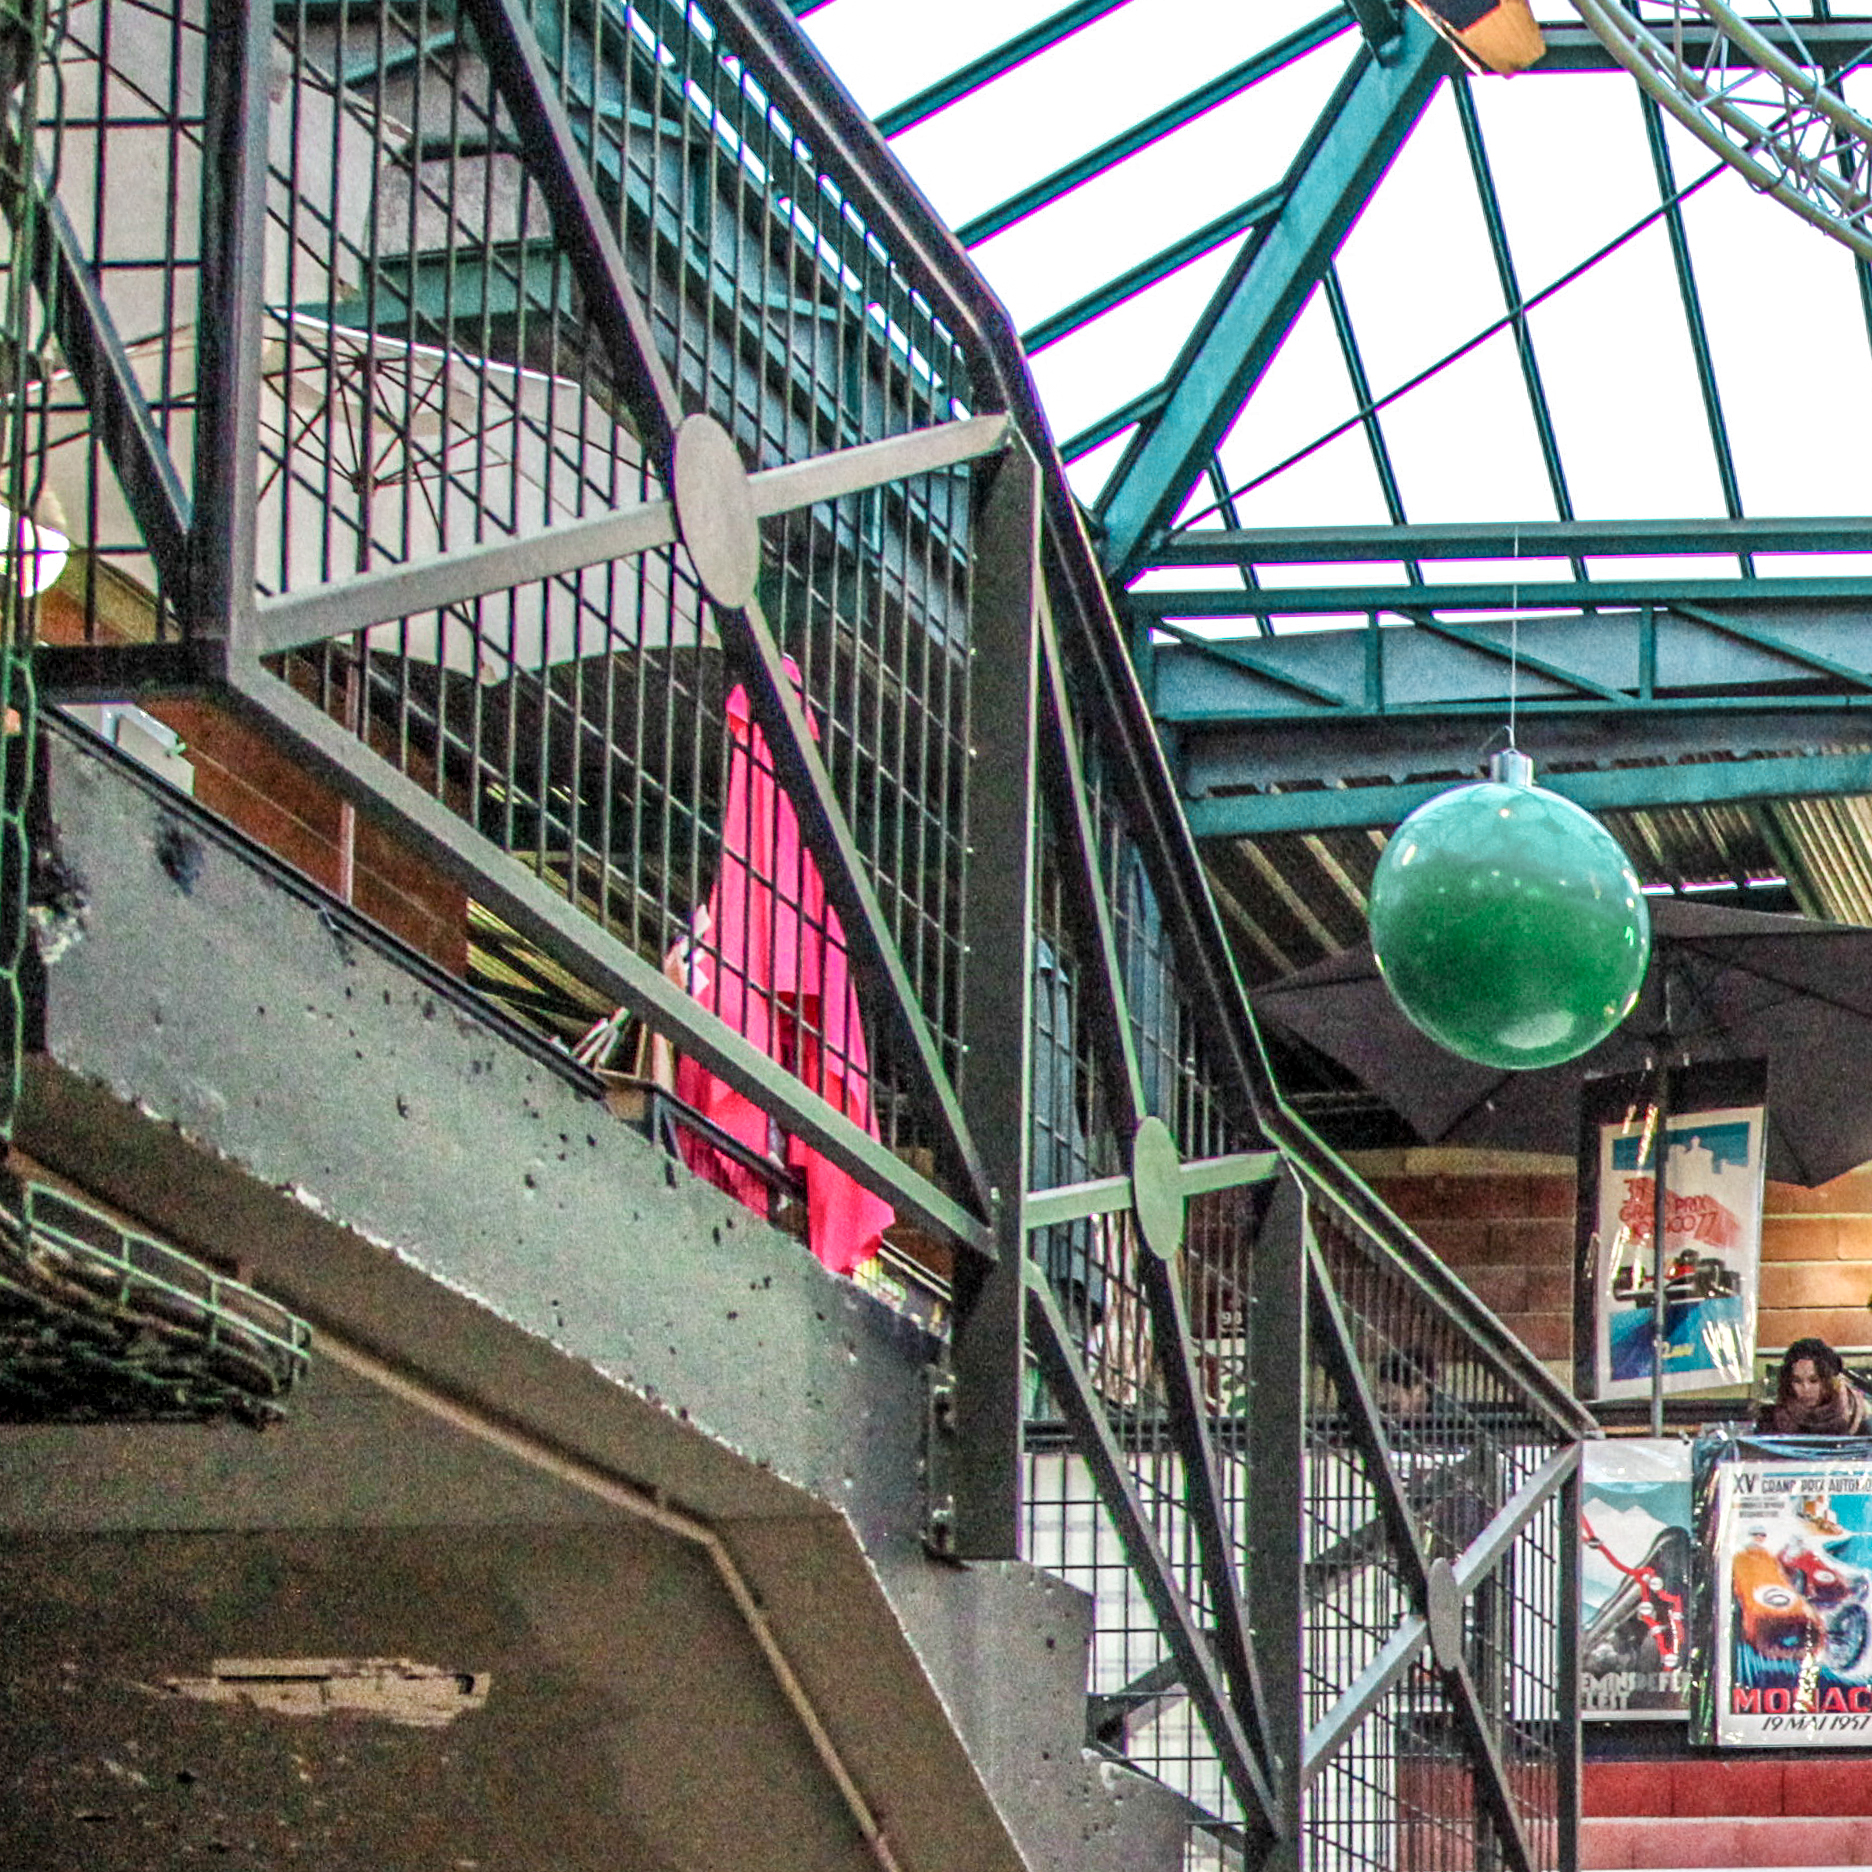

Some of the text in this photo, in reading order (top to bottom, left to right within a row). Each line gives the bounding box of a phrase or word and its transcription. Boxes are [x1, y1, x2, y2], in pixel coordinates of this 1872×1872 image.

[1733, 1473, 1756, 1494] XV
[1761, 1714, 1872, 1732] 19 MAI 1957
